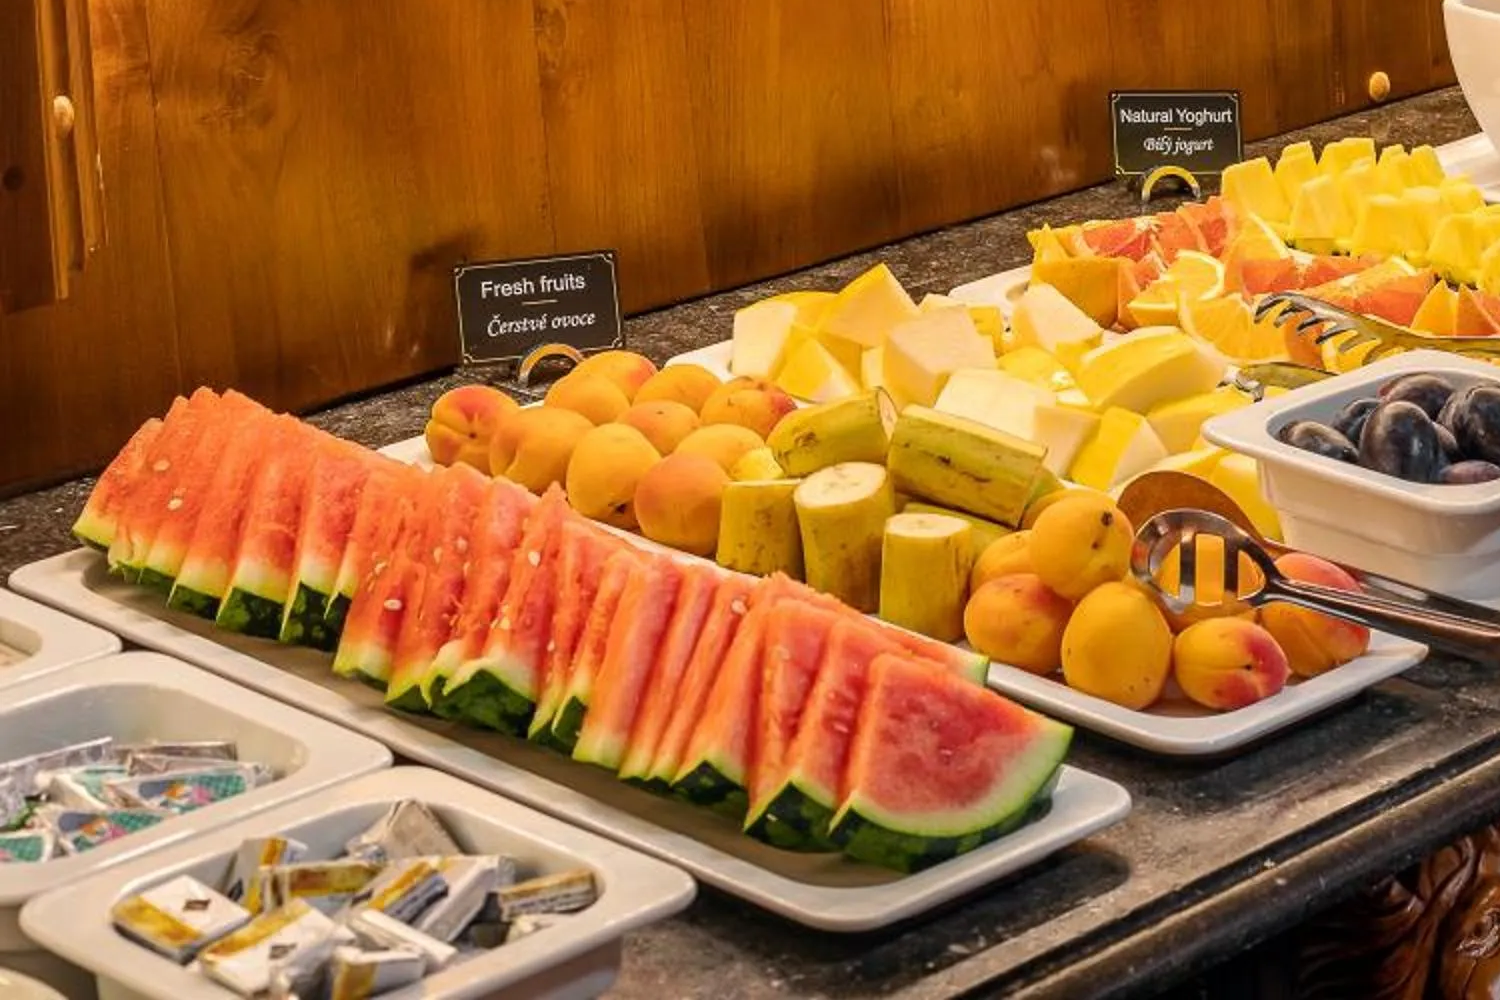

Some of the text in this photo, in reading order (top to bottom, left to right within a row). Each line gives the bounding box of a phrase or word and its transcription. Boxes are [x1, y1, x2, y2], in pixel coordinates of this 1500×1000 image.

[1120, 108, 1233, 127] Natural Yoghurt
[1173, 137, 1214, 156] jogurt
[481, 273, 586, 299] Fresh fruits
[487, 312, 597, 337] Čerstvé ovoce
